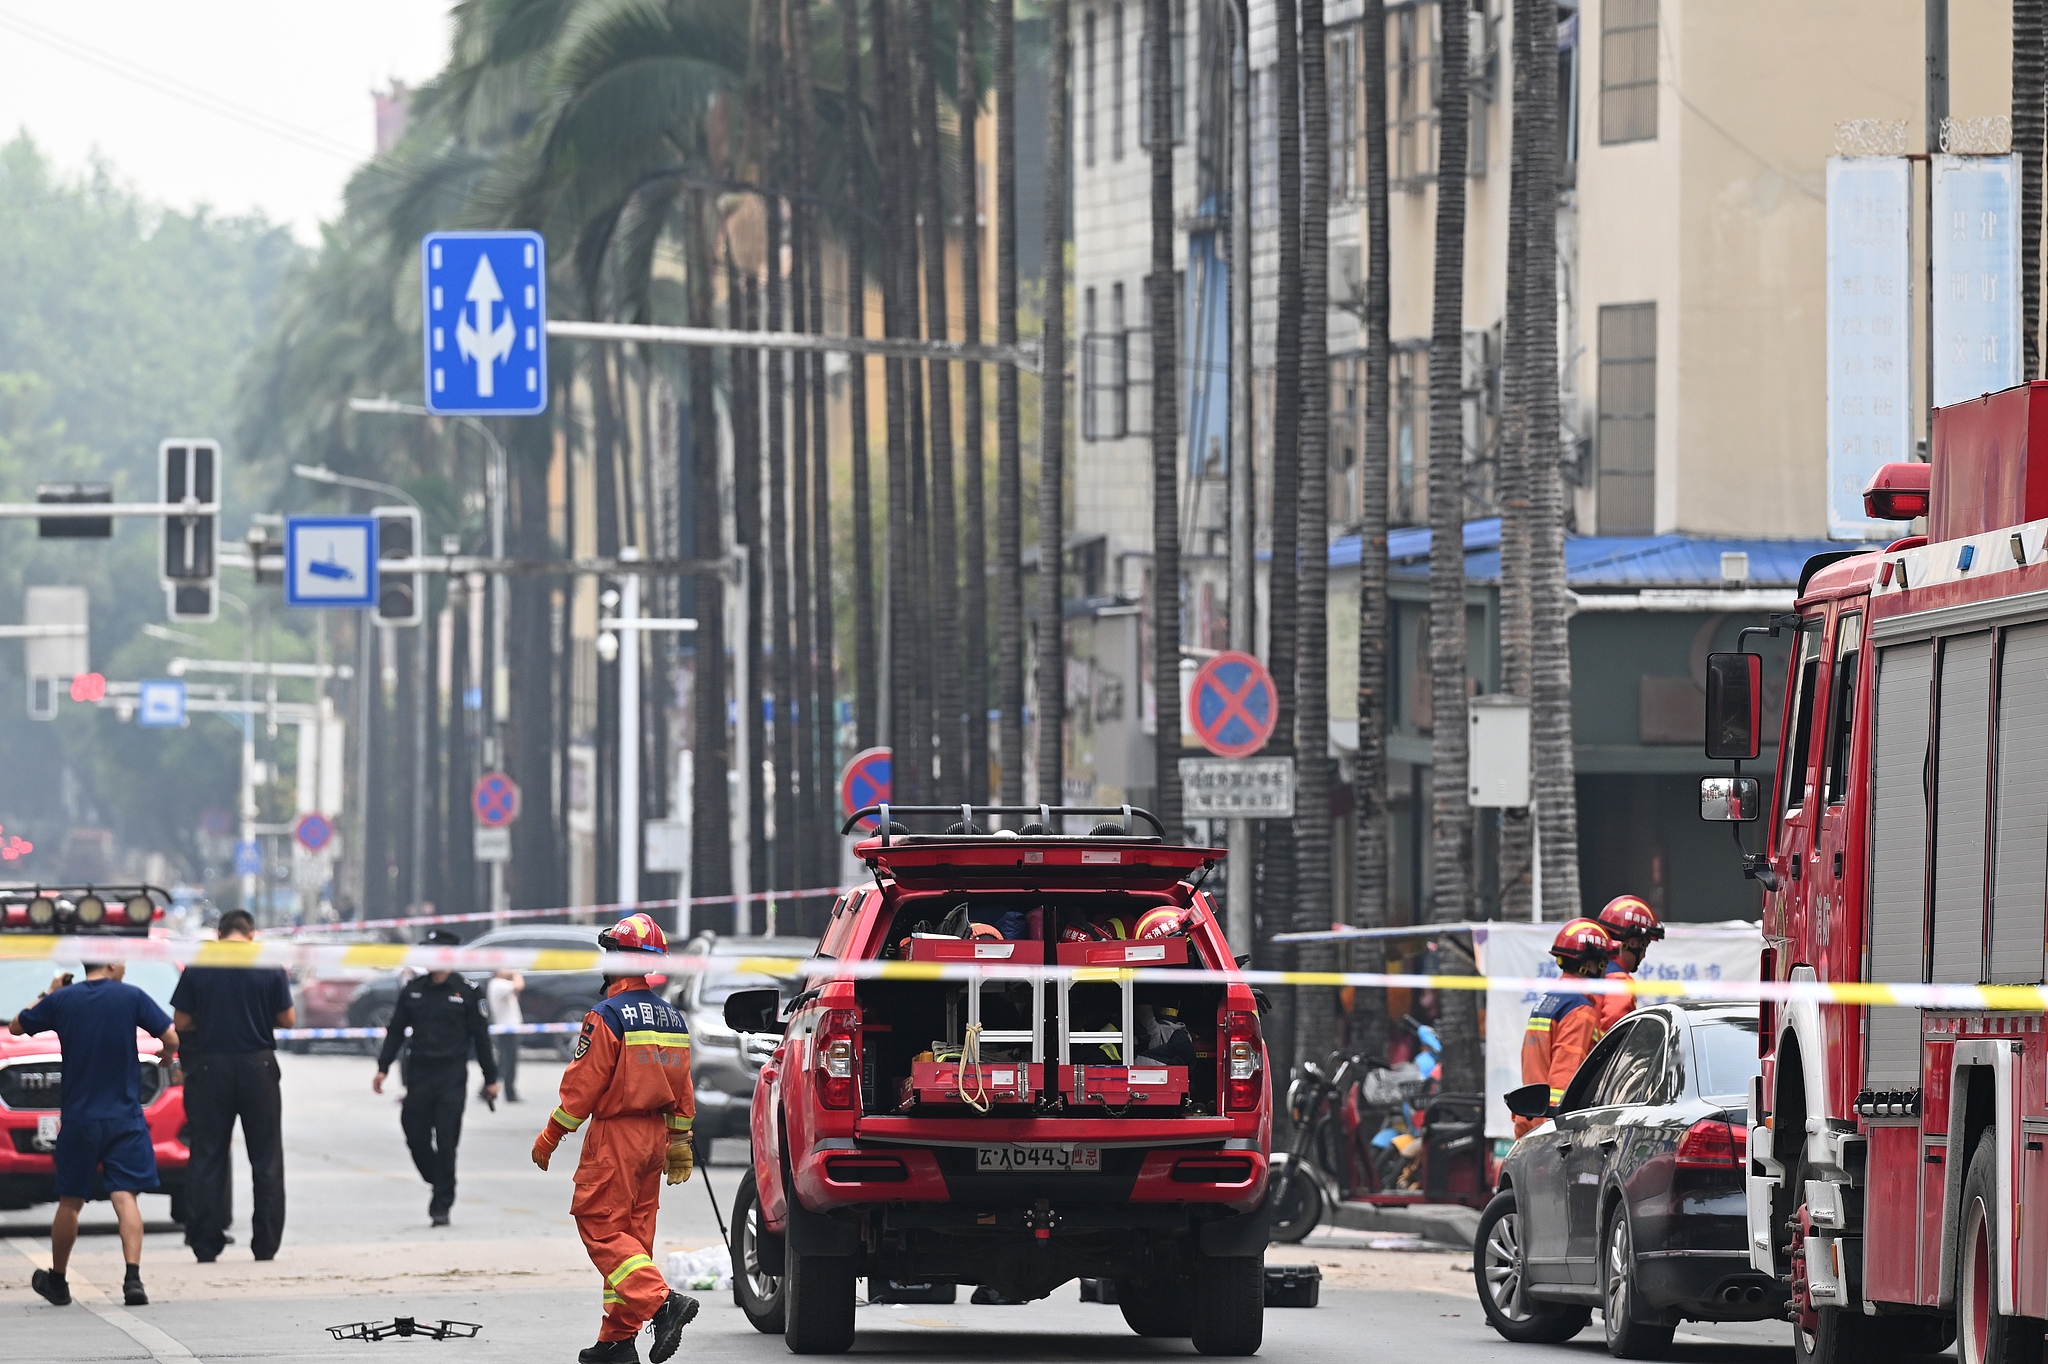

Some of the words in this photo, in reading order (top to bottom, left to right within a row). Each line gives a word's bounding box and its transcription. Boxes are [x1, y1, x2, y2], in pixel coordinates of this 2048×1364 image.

[1815, 893, 1831, 947] 消防
[620, 1002, 682, 1028] 中国消防
